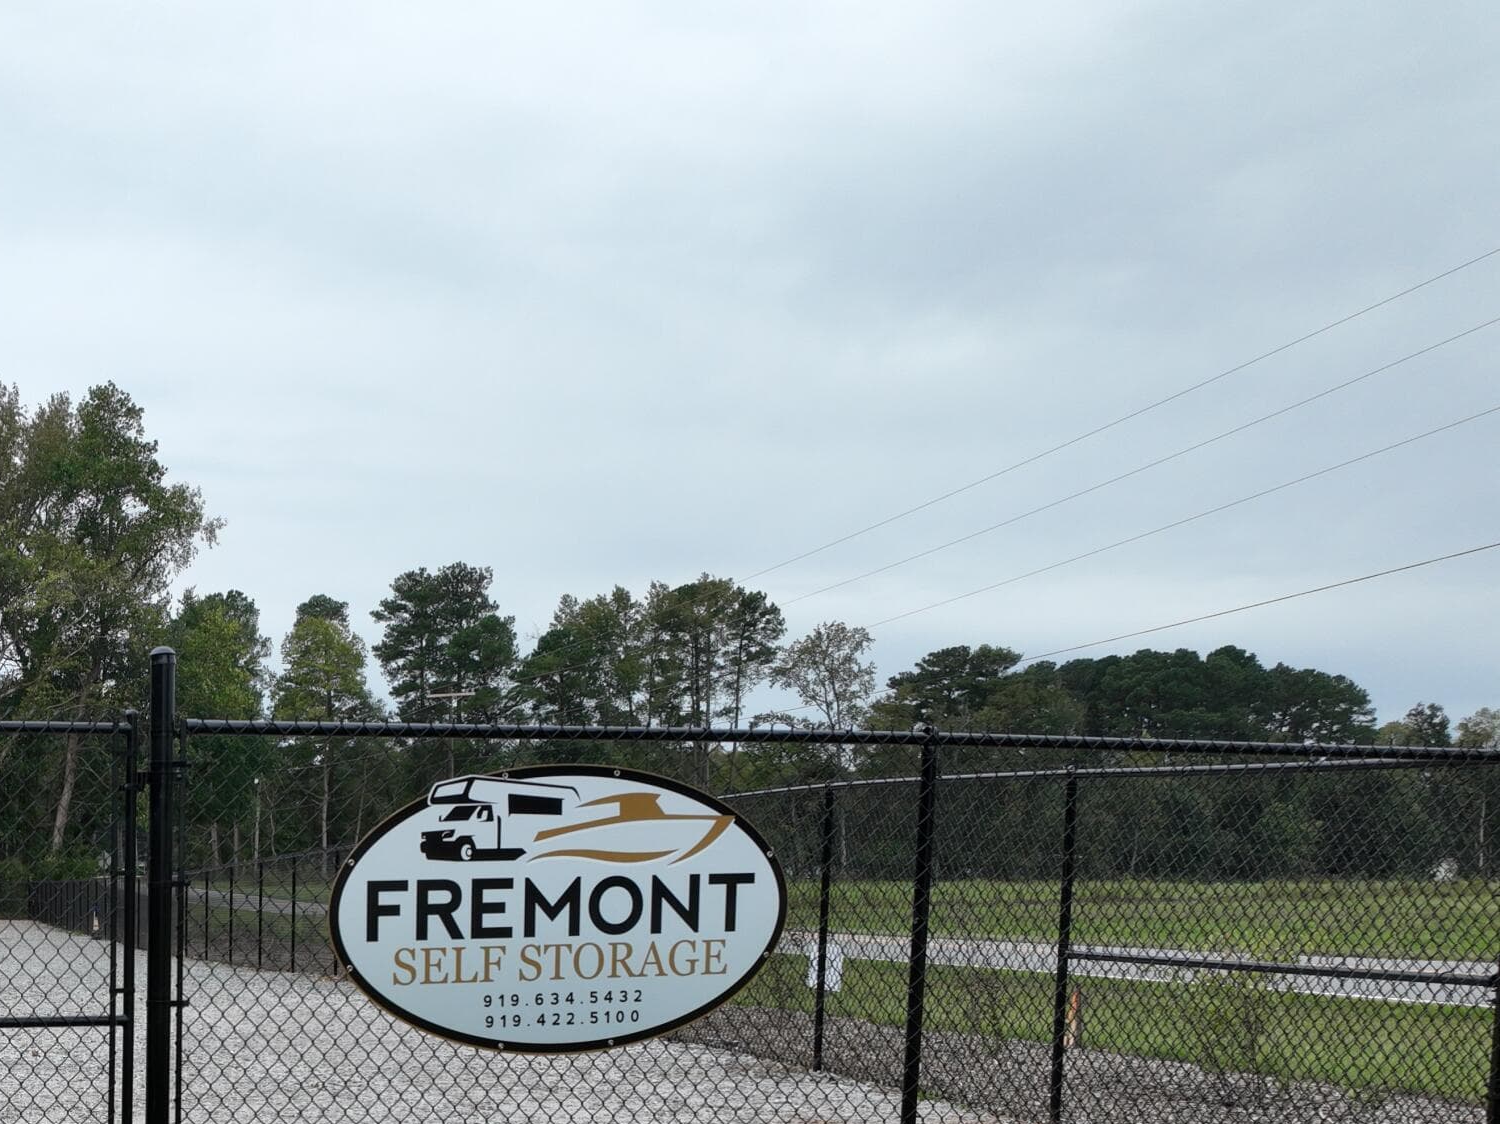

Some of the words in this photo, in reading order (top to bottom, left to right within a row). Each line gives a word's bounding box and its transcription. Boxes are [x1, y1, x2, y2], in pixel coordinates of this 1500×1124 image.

[365, 873, 755, 942] FREMONT
[392, 946, 506, 986] SELF
[518, 938, 728, 982] STORAGE
[483, 990, 644, 1008] 919.634.5432
[485, 1010, 640, 1029] 919.422.5100
